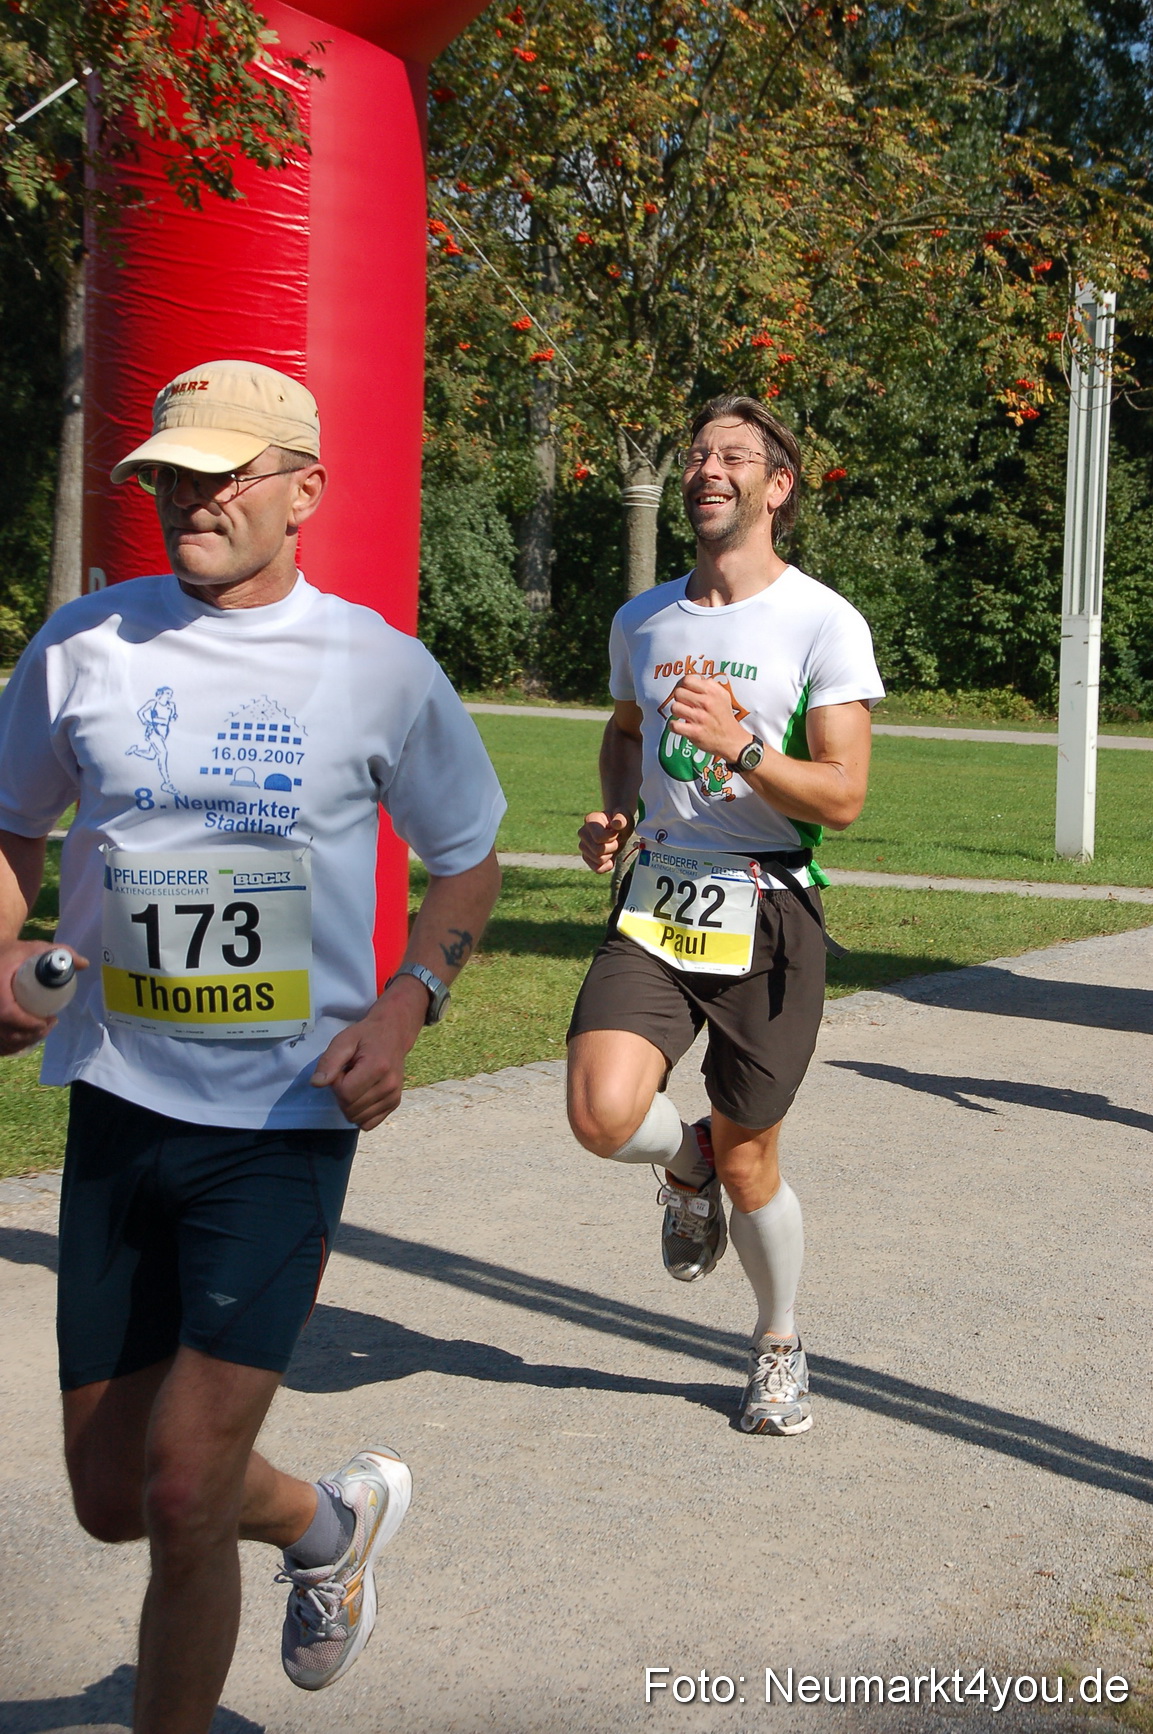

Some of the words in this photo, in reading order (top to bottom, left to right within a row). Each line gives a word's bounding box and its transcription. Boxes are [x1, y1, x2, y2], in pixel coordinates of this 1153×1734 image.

[719, 660, 758, 681] run
[211, 746, 305, 765] 16.09.2007
[174, 794, 300, 820] Neumarkter
[651, 851, 698, 870] PFLEIDERER
[113, 867, 209, 886] PFLEIDERER
[233, 871, 291, 885] BOCK
[115, 886, 209, 896] AKTIENGESELLSCHAFT
[652, 875, 726, 929] 222
[131, 901, 262, 970] 173
[659, 926, 707, 955] Paul
[128, 972, 275, 1013] Thomas
